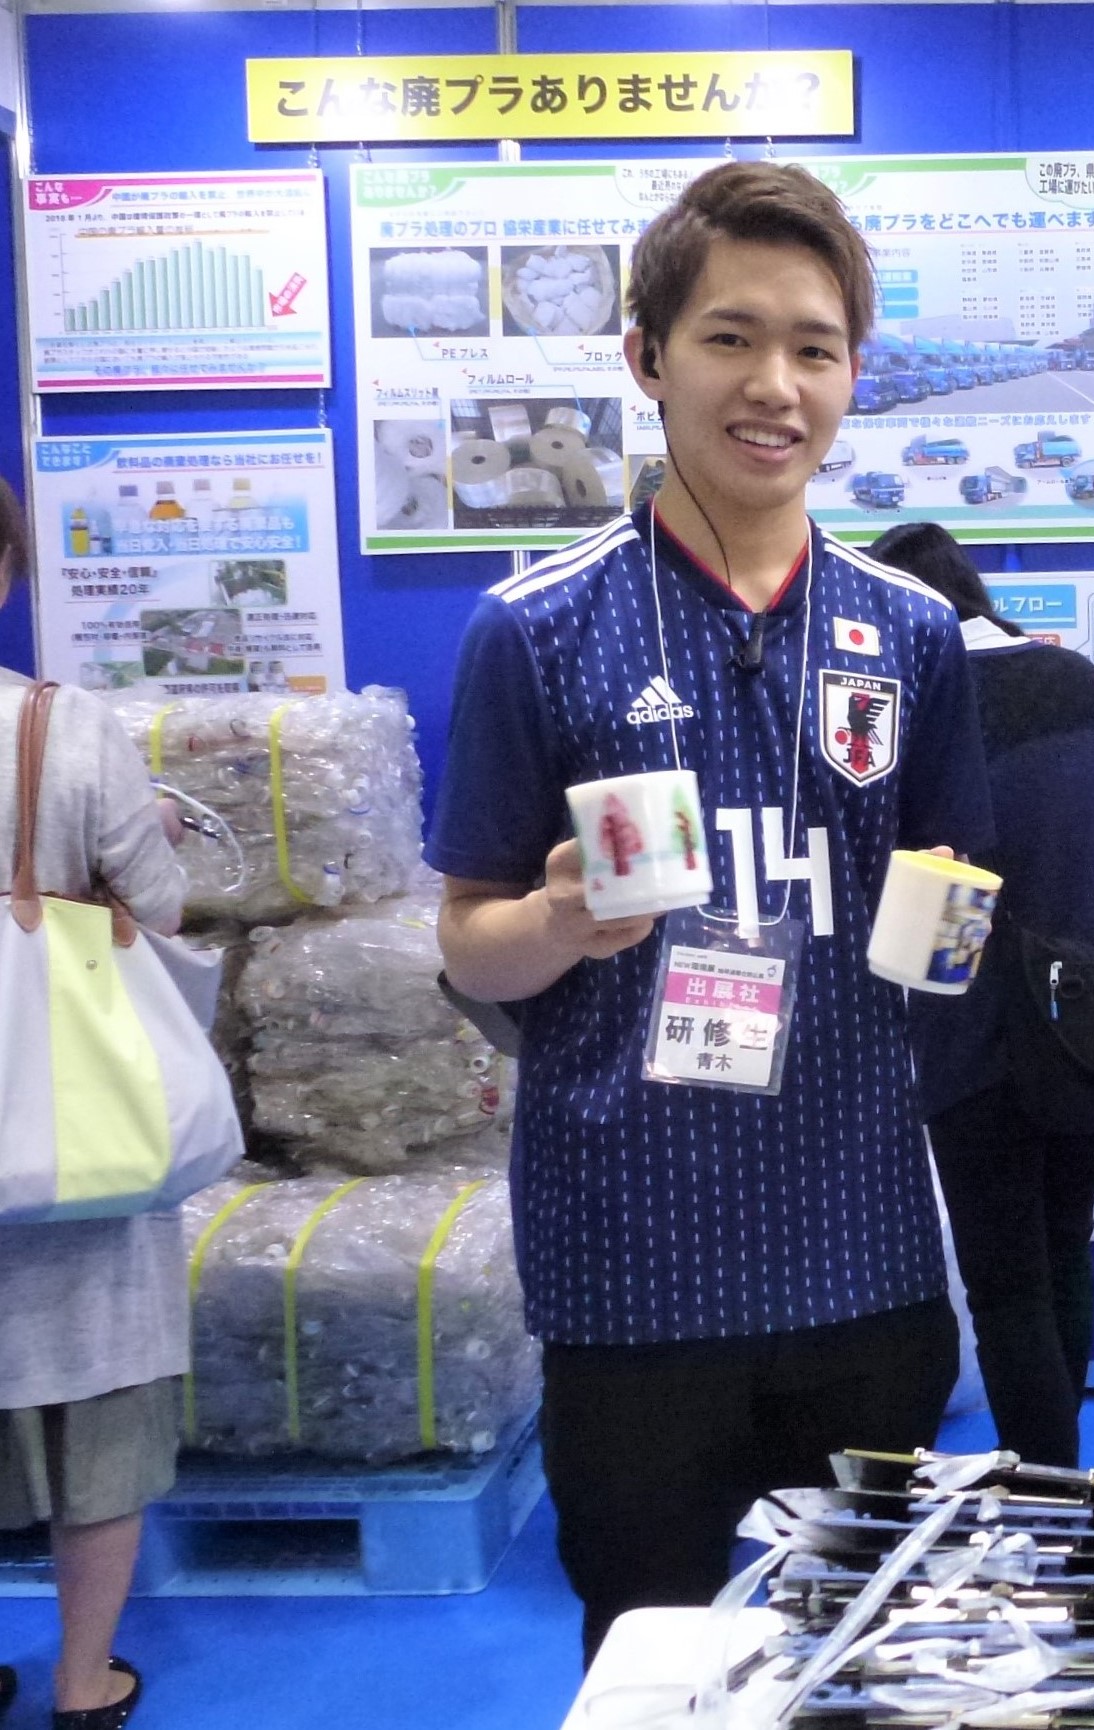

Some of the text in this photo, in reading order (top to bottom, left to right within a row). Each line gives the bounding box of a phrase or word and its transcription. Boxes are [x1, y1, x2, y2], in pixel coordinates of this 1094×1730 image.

[584, 351, 623, 362] ブロック
[467, 373, 535, 385] フィルムロール
[840, 676, 882, 691] JAPAN
[626, 703, 695, 725] adidas
[842, 746, 877, 768] JFA
[715, 806, 835, 940] 14
[686, 977, 760, 1004] 出展社
[665, 1014, 768, 1051] 研修生
[696, 1052, 733, 1072] 青木
